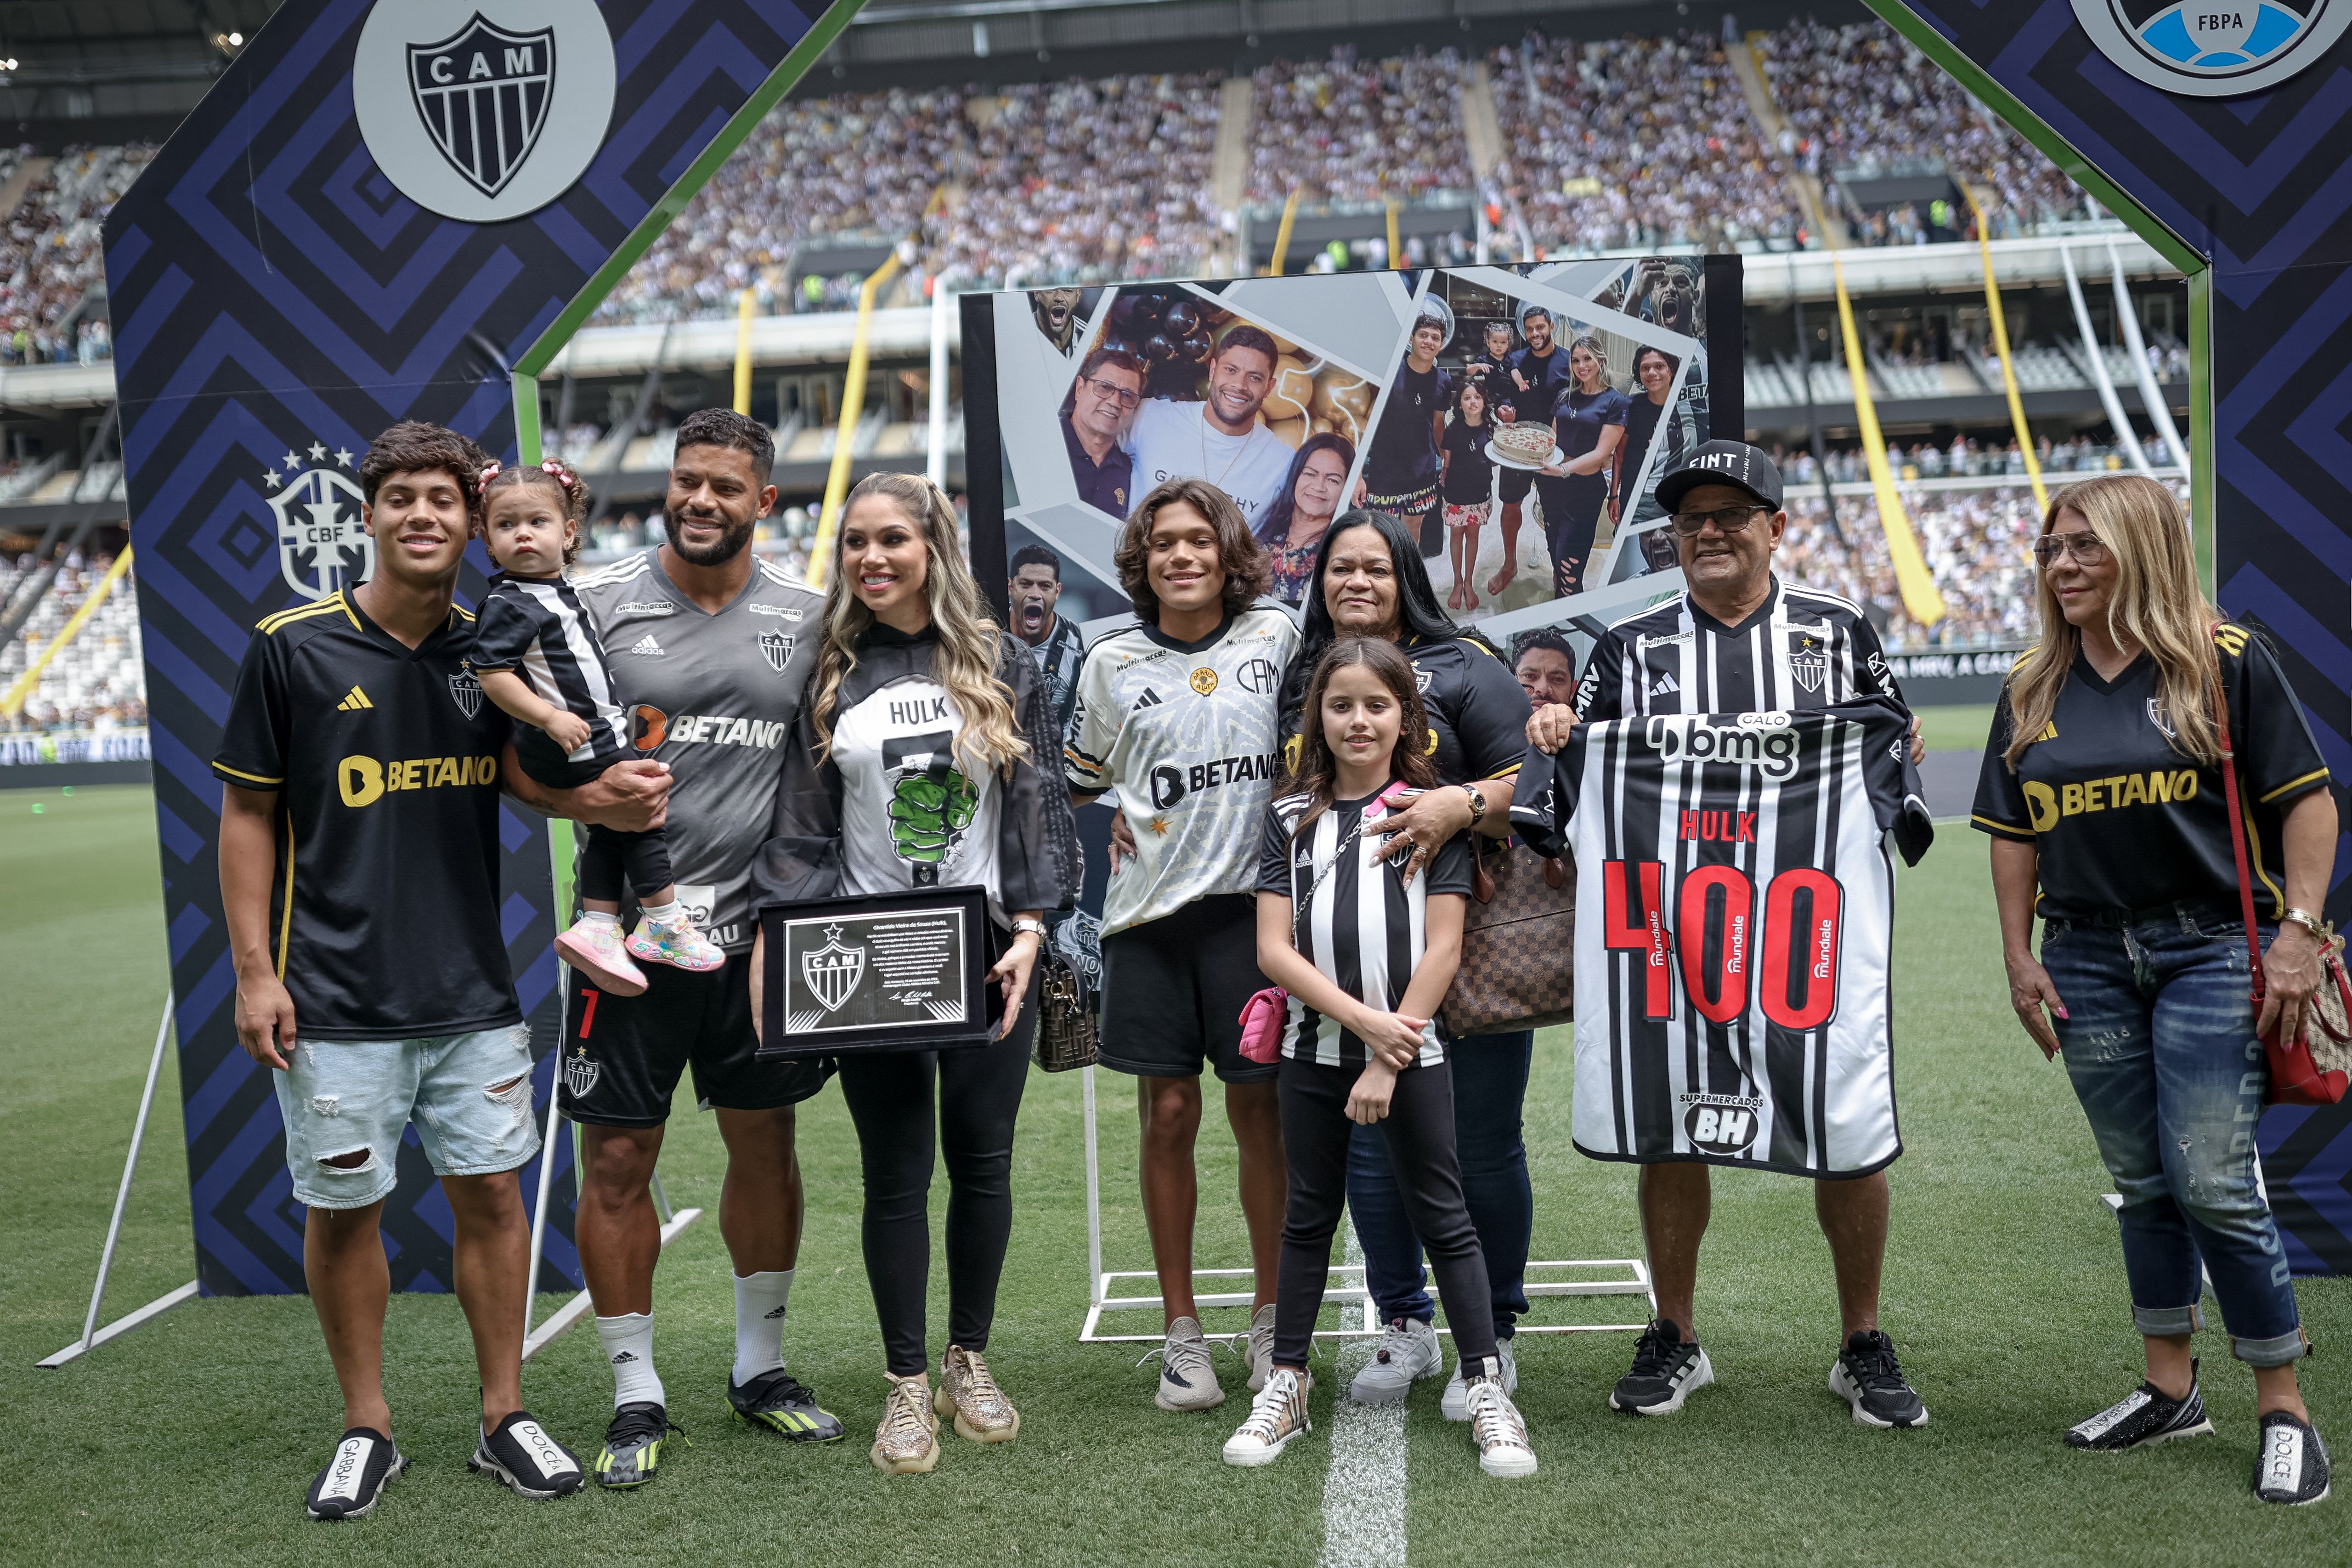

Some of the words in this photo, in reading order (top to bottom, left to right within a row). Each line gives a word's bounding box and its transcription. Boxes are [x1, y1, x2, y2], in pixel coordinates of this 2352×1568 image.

[2198, 12, 2243, 31] FBPA
[430, 46, 535, 83] CAM
[1678, 383, 1707, 402] BET
[1689, 453, 1736, 468] FINT
[306, 526, 345, 543] CBF
[618, 602, 672, 612] Multimarcas
[752, 605, 802, 615] Multimarcas
[1640, 630, 1694, 646] Multimarcas
[1774, 623, 1830, 632] Multimarcas
[631, 645, 664, 655] adidas
[765, 638, 789, 646] CAM
[1227, 635, 1275, 646] Multimarcas
[1116, 649, 1166, 672] Multimarcas
[1794, 657, 1822, 665] CAM
[456, 680, 479, 689] CAM
[1236, 658, 1279, 695] CAM
[1576, 663, 1600, 721] MRV
[889, 696, 948, 725] HULK
[1741, 714, 1786, 726] GALO
[669, 715, 785, 750] BETANO
[1689, 719, 1794, 777] bmg
[387, 756, 497, 792] BETANO
[2062, 769, 2198, 817] BETANO
[1680, 809, 1755, 843] HULK
[1603, 860, 1843, 1032] 400
[1650, 911, 1665, 967] mundiale
[1727, 915, 1744, 974] mundiale
[1814, 919, 1832, 979] mundiale
[812, 955, 855, 968] CAM
[571, 1063, 593, 1073] CAM
[1679, 1094, 1764, 1108] SUPERMERCADOS
[1694, 1109, 1751, 1144] BH
[522, 1426, 562, 1465] DOLCE
[328, 1439, 361, 1497] GABBANA
